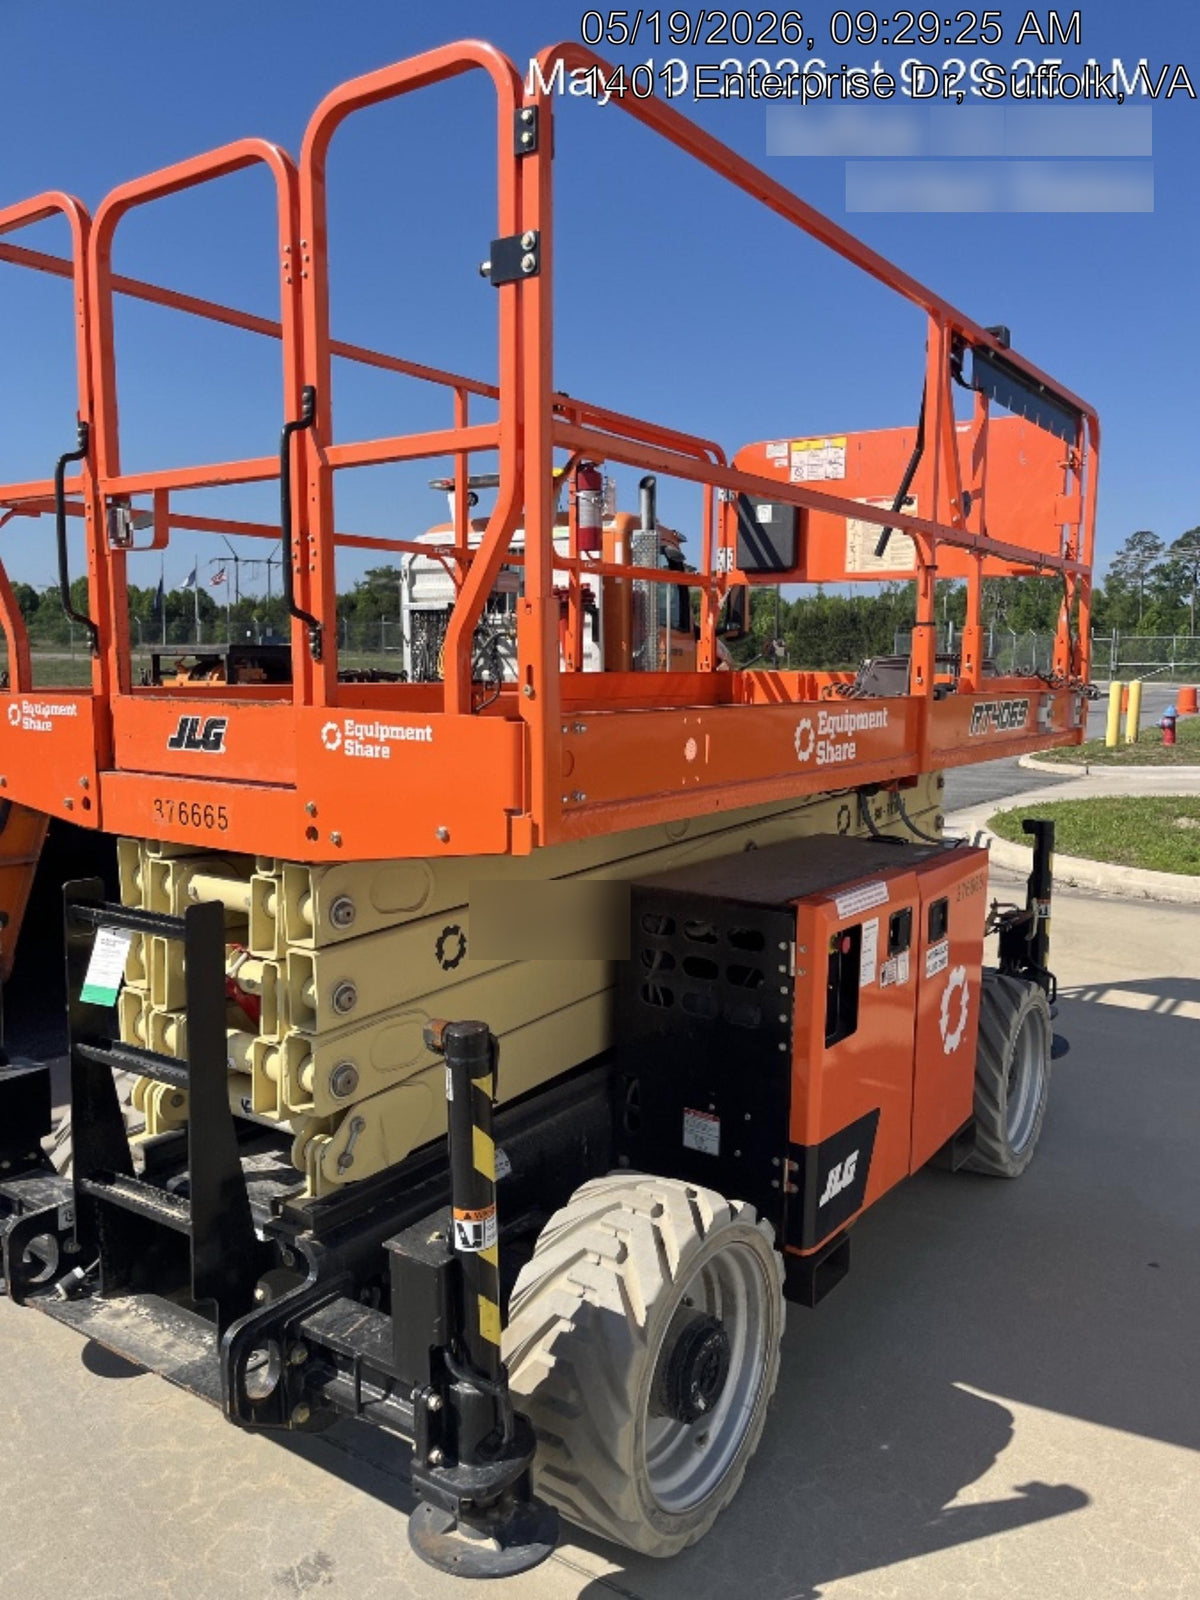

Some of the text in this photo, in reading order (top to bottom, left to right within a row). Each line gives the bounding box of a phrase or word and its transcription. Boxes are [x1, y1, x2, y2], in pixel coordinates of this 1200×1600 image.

[22, 700, 78, 718] Equipment
[22, 717, 52, 731] Share
[167, 715, 228, 753] JLG
[344, 719, 433, 742] Equipment
[817, 707, 889, 740] Equipment
[344, 739, 390, 759] Share
[816, 740, 856, 765] Share
[154, 798, 229, 830] 376665
[819, 1149, 860, 1208] JLG
